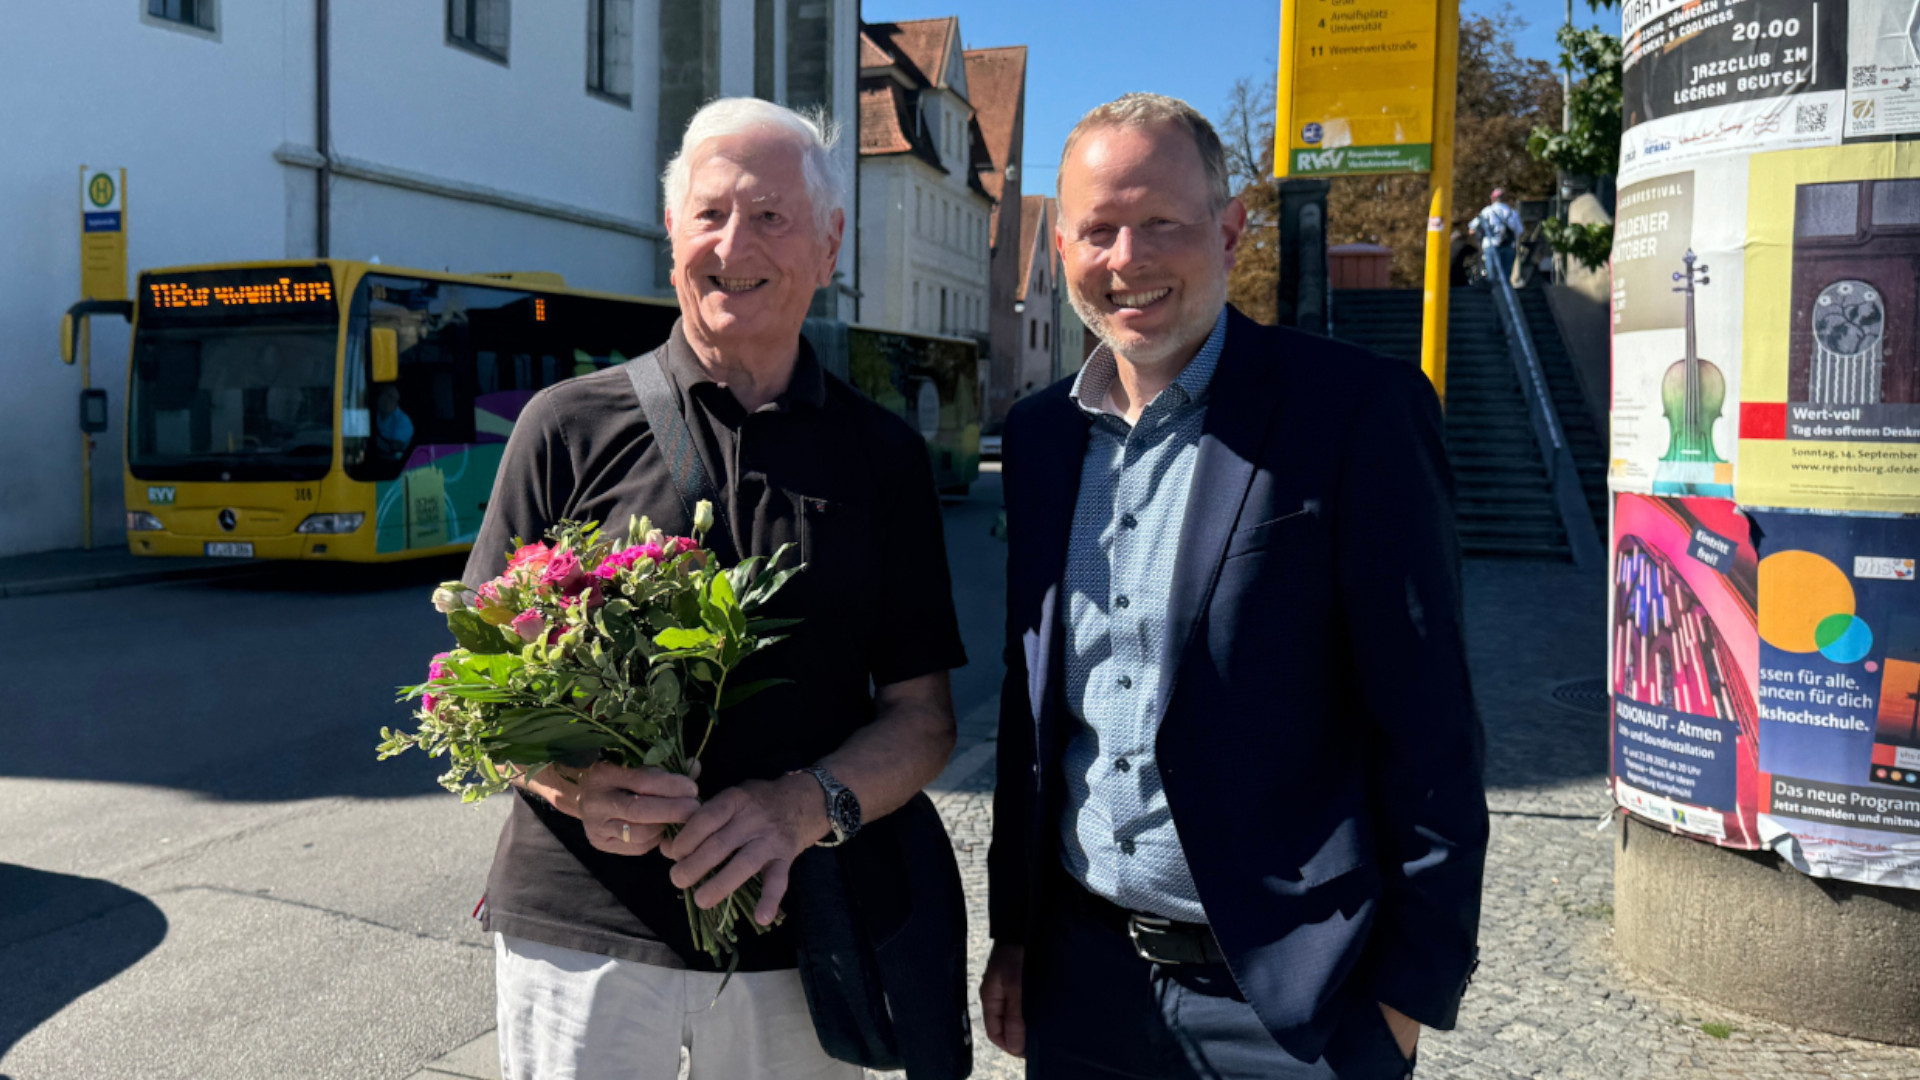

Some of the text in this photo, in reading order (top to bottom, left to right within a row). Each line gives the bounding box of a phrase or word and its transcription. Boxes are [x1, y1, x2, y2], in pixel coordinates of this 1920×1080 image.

[1318, 18, 1325, 28] 4
[1330, 22, 1382, 33] Universität
[1679, 9, 1734, 37] COOLNESS
[1732, 18, 1800, 42] 20.00
[1311, 46, 1323, 57] 11
[1690, 52, 1771, 85] JAZZCLUB
[1783, 46, 1807, 64] IM
[1737, 69, 1806, 92] BEUTEL
[1793, 407, 1860, 421] Wert-voll
[1792, 425, 1811, 437] Tag
[1813, 425, 1832, 436] des
[1835, 425, 1880, 436] offenen
[1792, 448, 1838, 459] Sonntag,
[1858, 449, 1918, 460] September
[148, 487, 175, 501] RVV
[1696, 529, 1729, 555] Eintritt
[1697, 546, 1718, 566] frei!
[1798, 669, 1823, 685] für
[1825, 673, 1860, 690] alle.
[1759, 685, 1873, 709] ancen für dich
[1677, 720, 1722, 743] Atmen
[1775, 781, 1803, 798] Das
[1807, 788, 1847, 804] neue
[1774, 800, 1799, 813] Jetzt
[1801, 804, 1856, 821] anmelden
[1858, 813, 1880, 824] und
